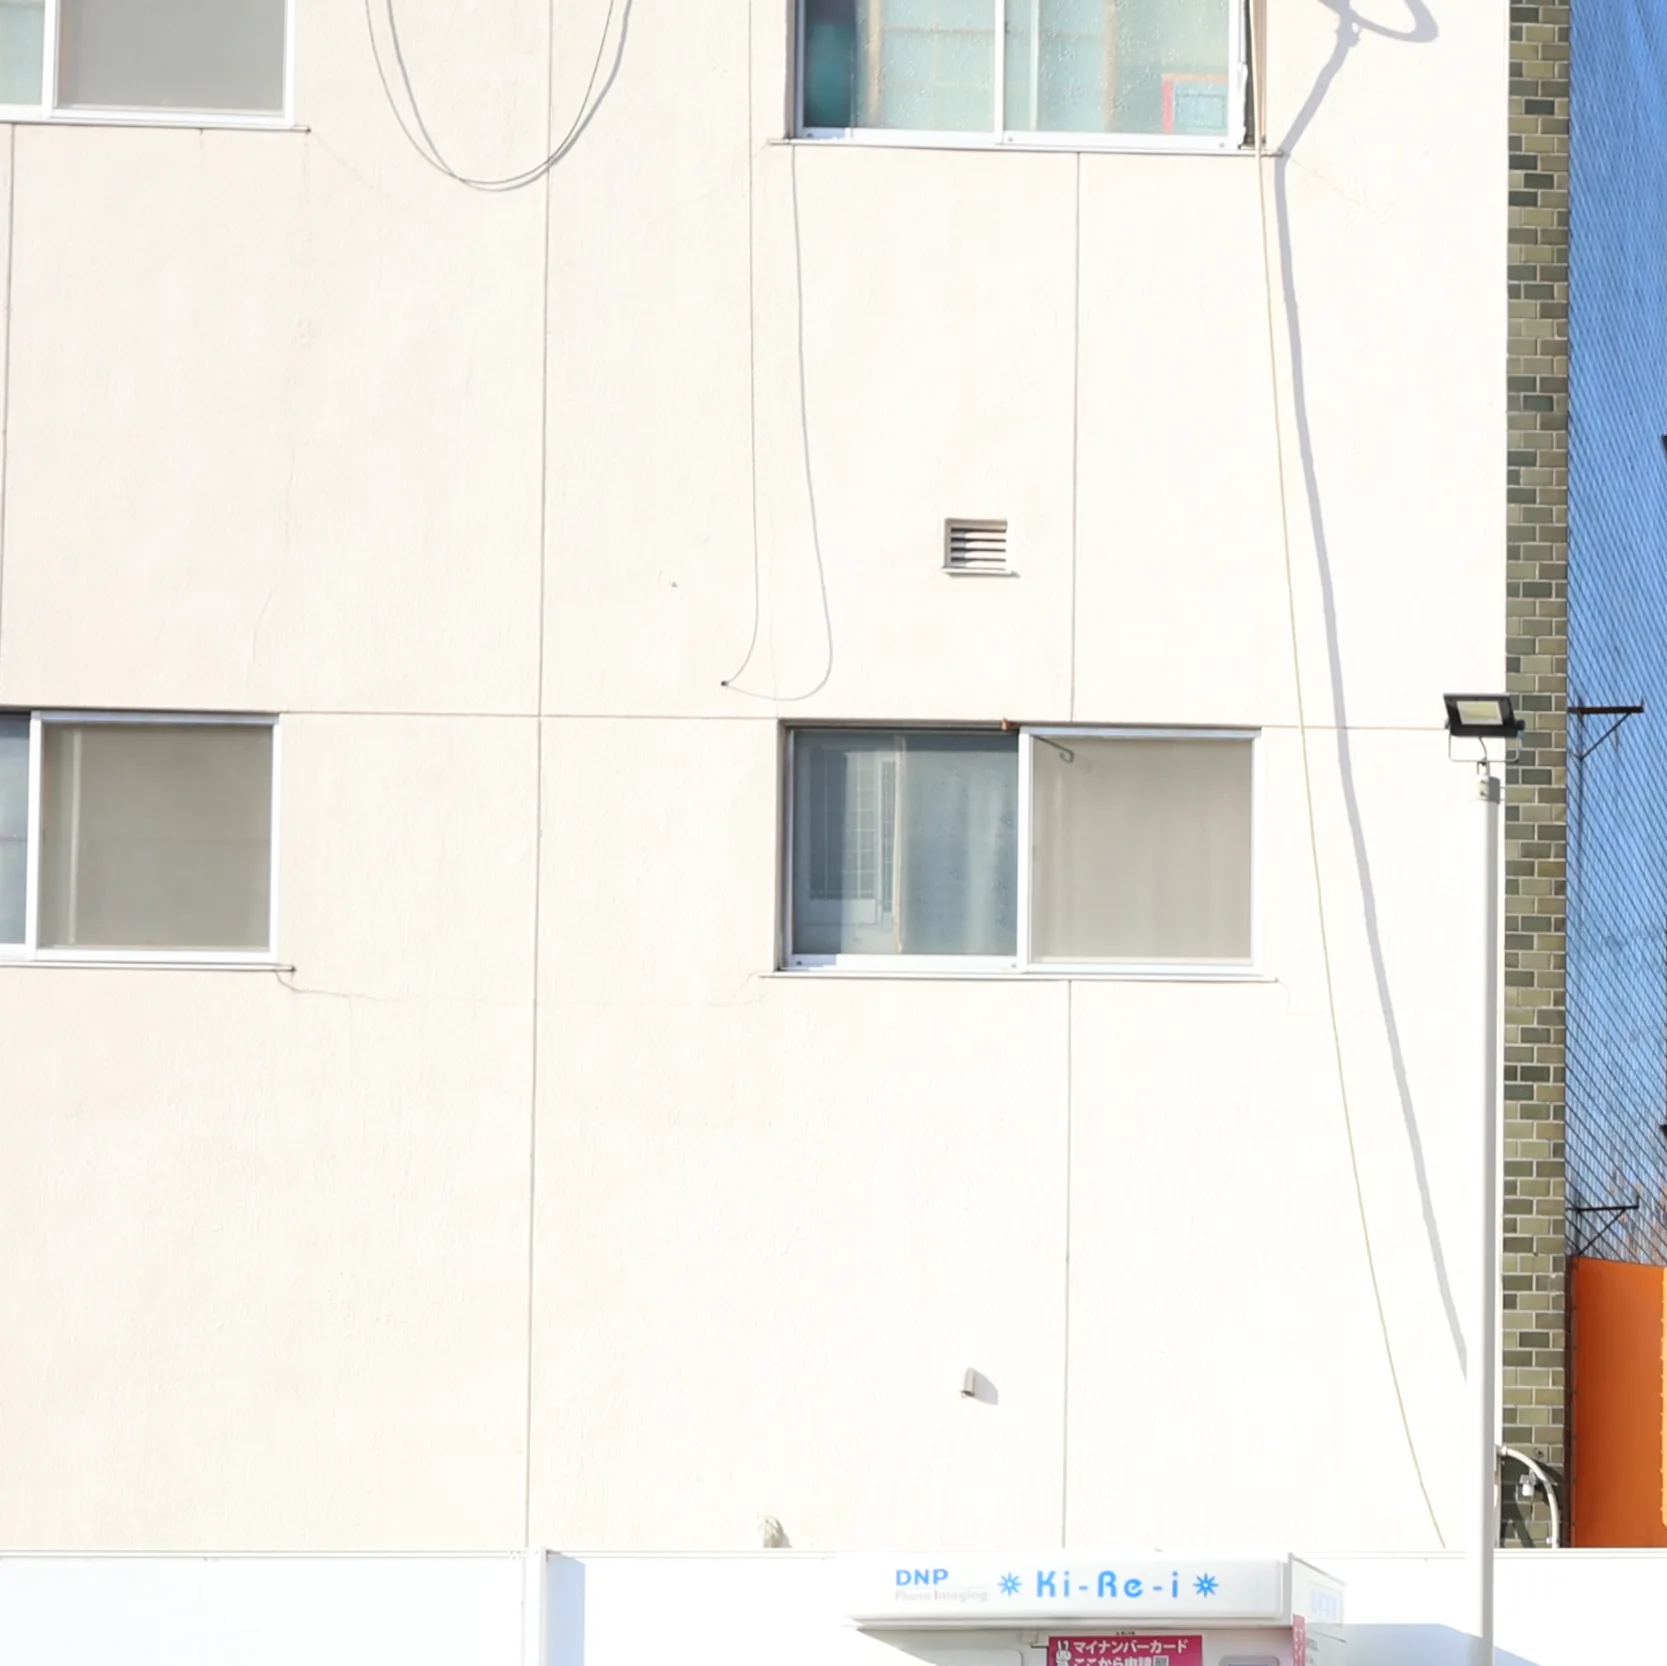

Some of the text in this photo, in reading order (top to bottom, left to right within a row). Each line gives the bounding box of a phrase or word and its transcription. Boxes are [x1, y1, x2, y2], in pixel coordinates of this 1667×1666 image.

[895, 1568, 949, 1586] DNP
[934, 1589, 988, 1602] Imaging
[1073, 1639, 1188, 1654] マイナンバーカード
